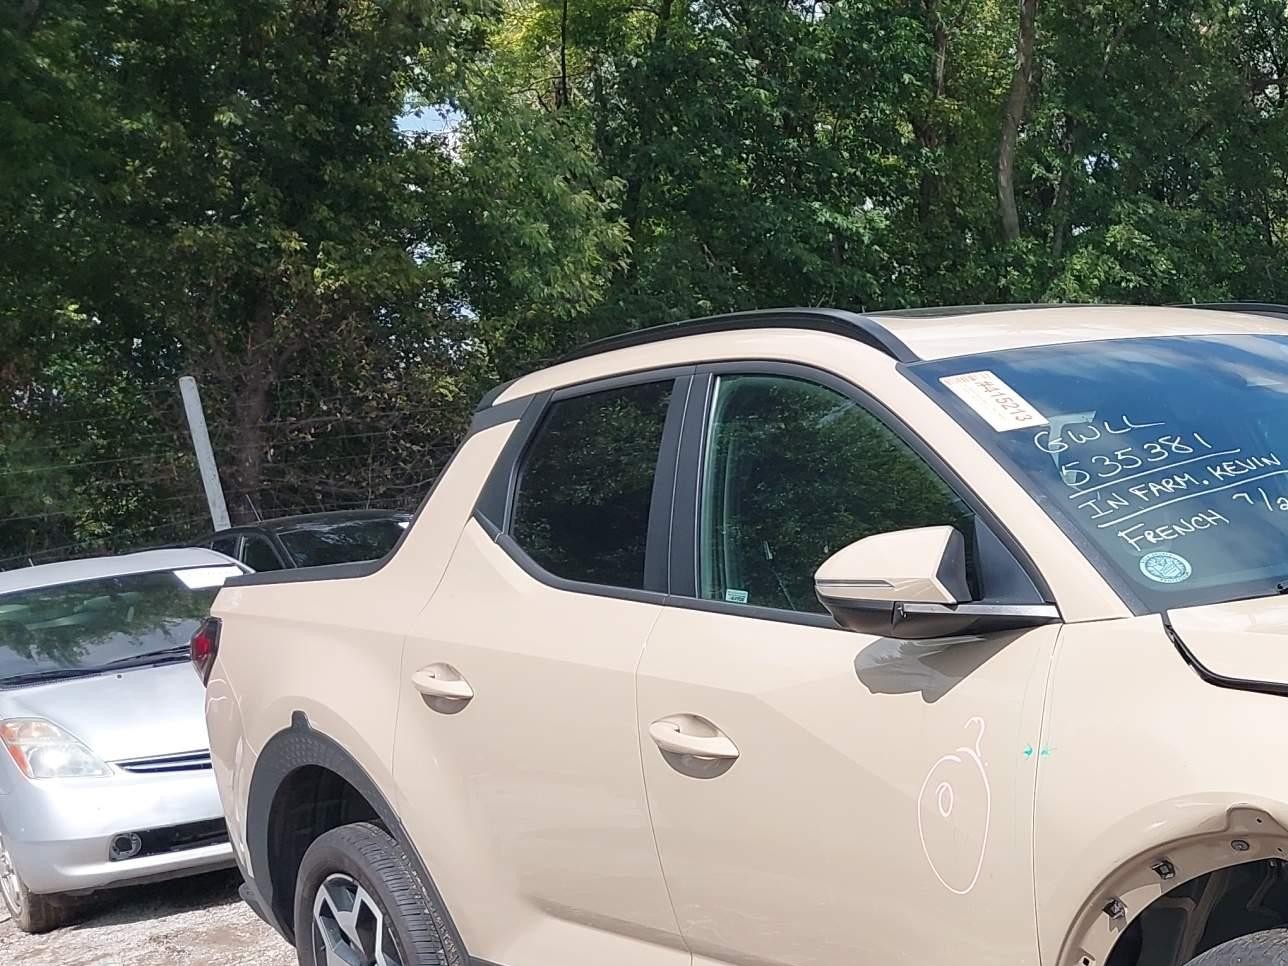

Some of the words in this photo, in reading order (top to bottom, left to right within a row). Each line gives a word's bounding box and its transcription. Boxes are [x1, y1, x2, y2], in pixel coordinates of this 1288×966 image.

[1034, 416, 1165, 453] GWLL
[1061, 433, 1212, 486] 535381
[1078, 492, 1130, 519] IN
[1207, 453, 1281, 481] KEVIN
[1117, 509, 1230, 551] FRENCH
